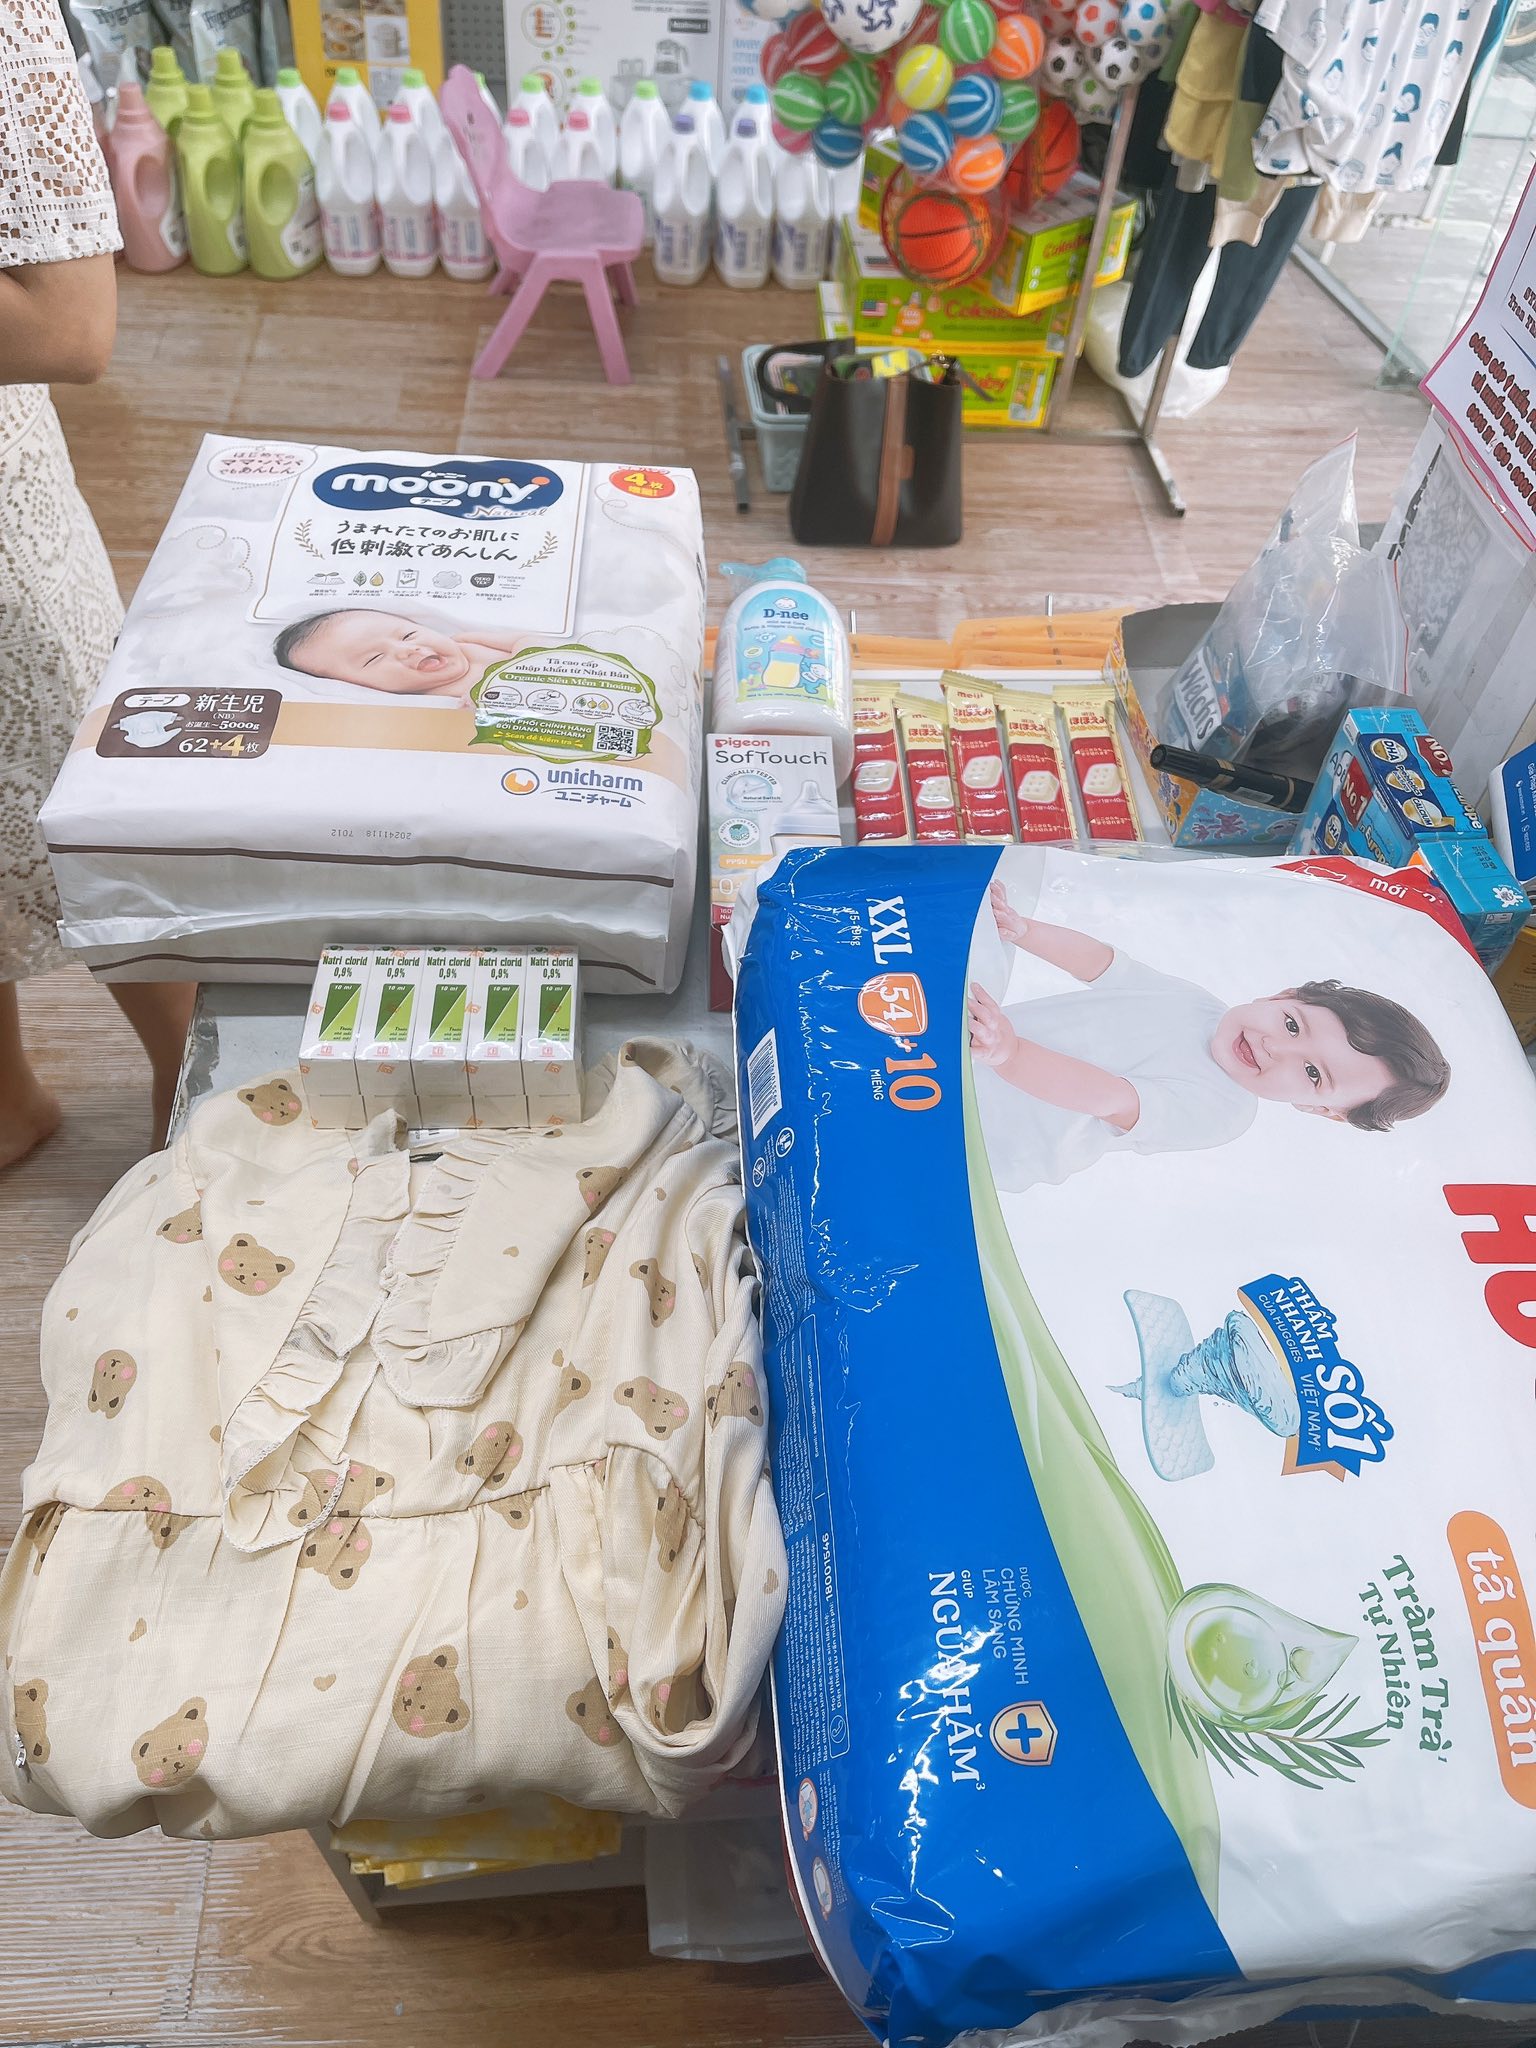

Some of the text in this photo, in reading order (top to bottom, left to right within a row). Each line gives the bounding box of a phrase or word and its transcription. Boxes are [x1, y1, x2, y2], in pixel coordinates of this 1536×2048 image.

[331, 474, 550, 505] moony
[465, 505, 549, 519] Natural
[337, 520, 520, 542] うまれたてのお肌に
[330, 537, 518, 562] 低刺激であんしん
[764, 608, 809, 620] D-nee
[505, 673, 546, 683] Organic
[547, 675, 569, 684] Siêu
[599, 681, 637, 693] Thoáng
[139, 695, 179, 706] テープ
[193, 694, 265, 713] 新生児
[1180, 662, 1214, 740] Welch's
[512, 725, 539, 733] DIANA
[540, 728, 587, 739] UNICHARM
[715, 737, 770, 748] pigeon
[1384, 740, 1399, 762] DHA
[547, 768, 644, 792] unicharm
[554, 791, 633, 808] ユニ・チャーム
[1412, 799, 1433, 826] CALCIUM
[1369, 877, 1409, 899] mới
[866, 895, 913, 965] XXL
[322, 956, 368, 966] Natri clorid
[375, 956, 420, 966] Natri clorid
[427, 957, 471, 967] Natri clorid
[478, 957, 522, 967] Natri clorid
[530, 957, 574, 967] Natri clorid
[333, 967, 353, 978] 0,9%
[387, 967, 406, 978] 0,9%
[438, 968, 457, 979] 0,9%
[491, 968, 509, 979] 0,9%
[543, 968, 561, 979] 0,9%
[878, 986, 914, 1022] 54
[870, 1068, 885, 1101] MIẾNG
[1288, 1280, 1334, 1340] THẤM
[1258, 1294, 1303, 1363] CỦA HUGGIES
[1269, 1288, 1323, 1360] NHANH
[1300, 1373, 1321, 1407] VIỆT
[821, 1532, 832, 1601] 18001546
[1466, 1547, 1516, 1605] tã
[960, 1569, 974, 1599] GIÚP
[982, 1569, 1000, 1604] LÂM
[1019, 1567, 1032, 1598] ĐƯỢC
[1382, 1554, 1439, 1670] Tràm
[1000, 1567, 1029, 1685] CHỨNG MINH
[1359, 1582, 1411, 1730] Tự Nhiên
